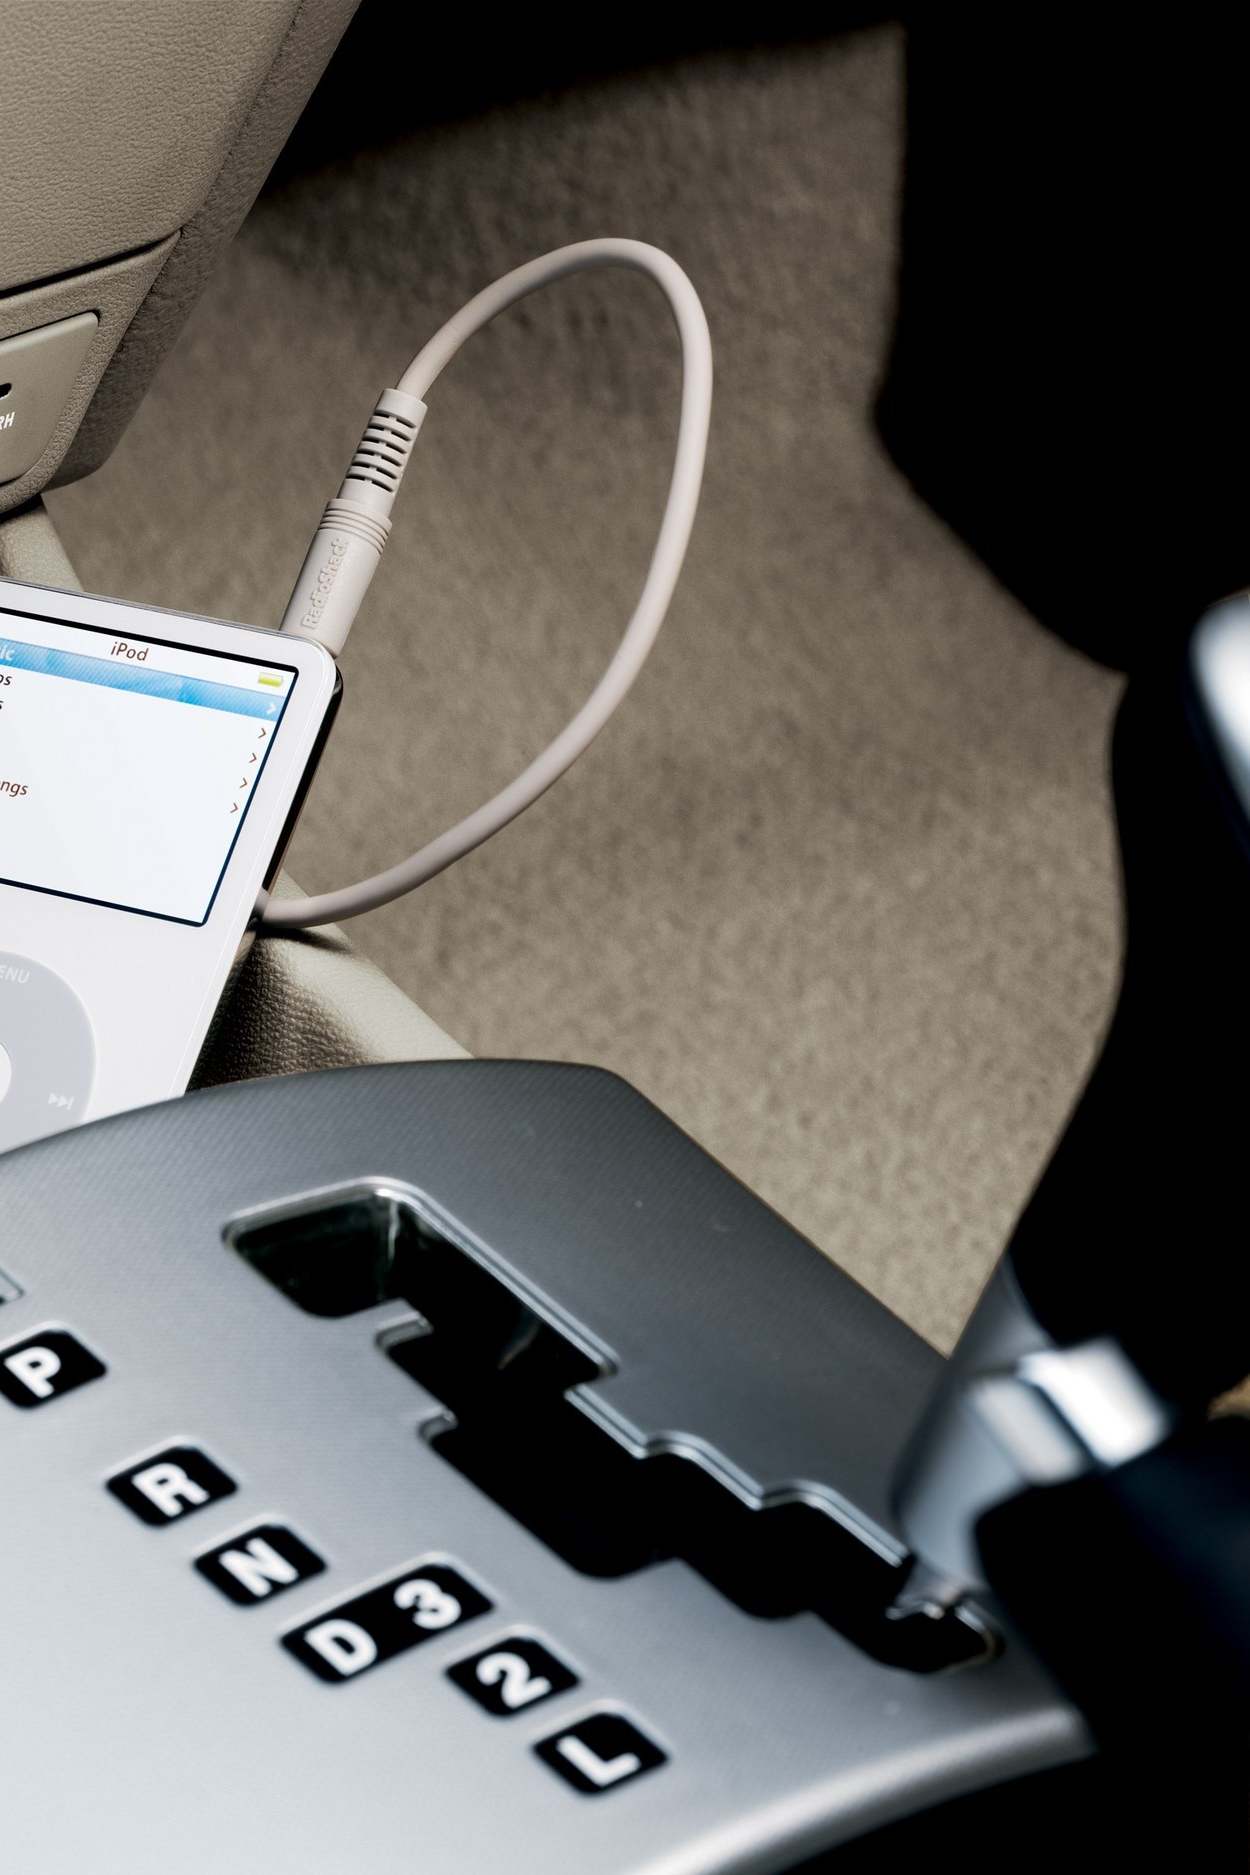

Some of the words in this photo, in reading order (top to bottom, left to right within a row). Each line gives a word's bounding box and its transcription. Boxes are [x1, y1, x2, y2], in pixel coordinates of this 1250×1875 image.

[301, 536, 350, 630] RadioShack
[110, 641, 149, 663] iPod
[3, 1346, 61, 1399] P
[131, 1462, 209, 1517] R
[219, 1537, 299, 1598] N
[303, 1619, 378, 1676] D
[393, 1578, 462, 1629] 3
[476, 1652, 551, 1708] 2
[556, 1735, 642, 1787] L
